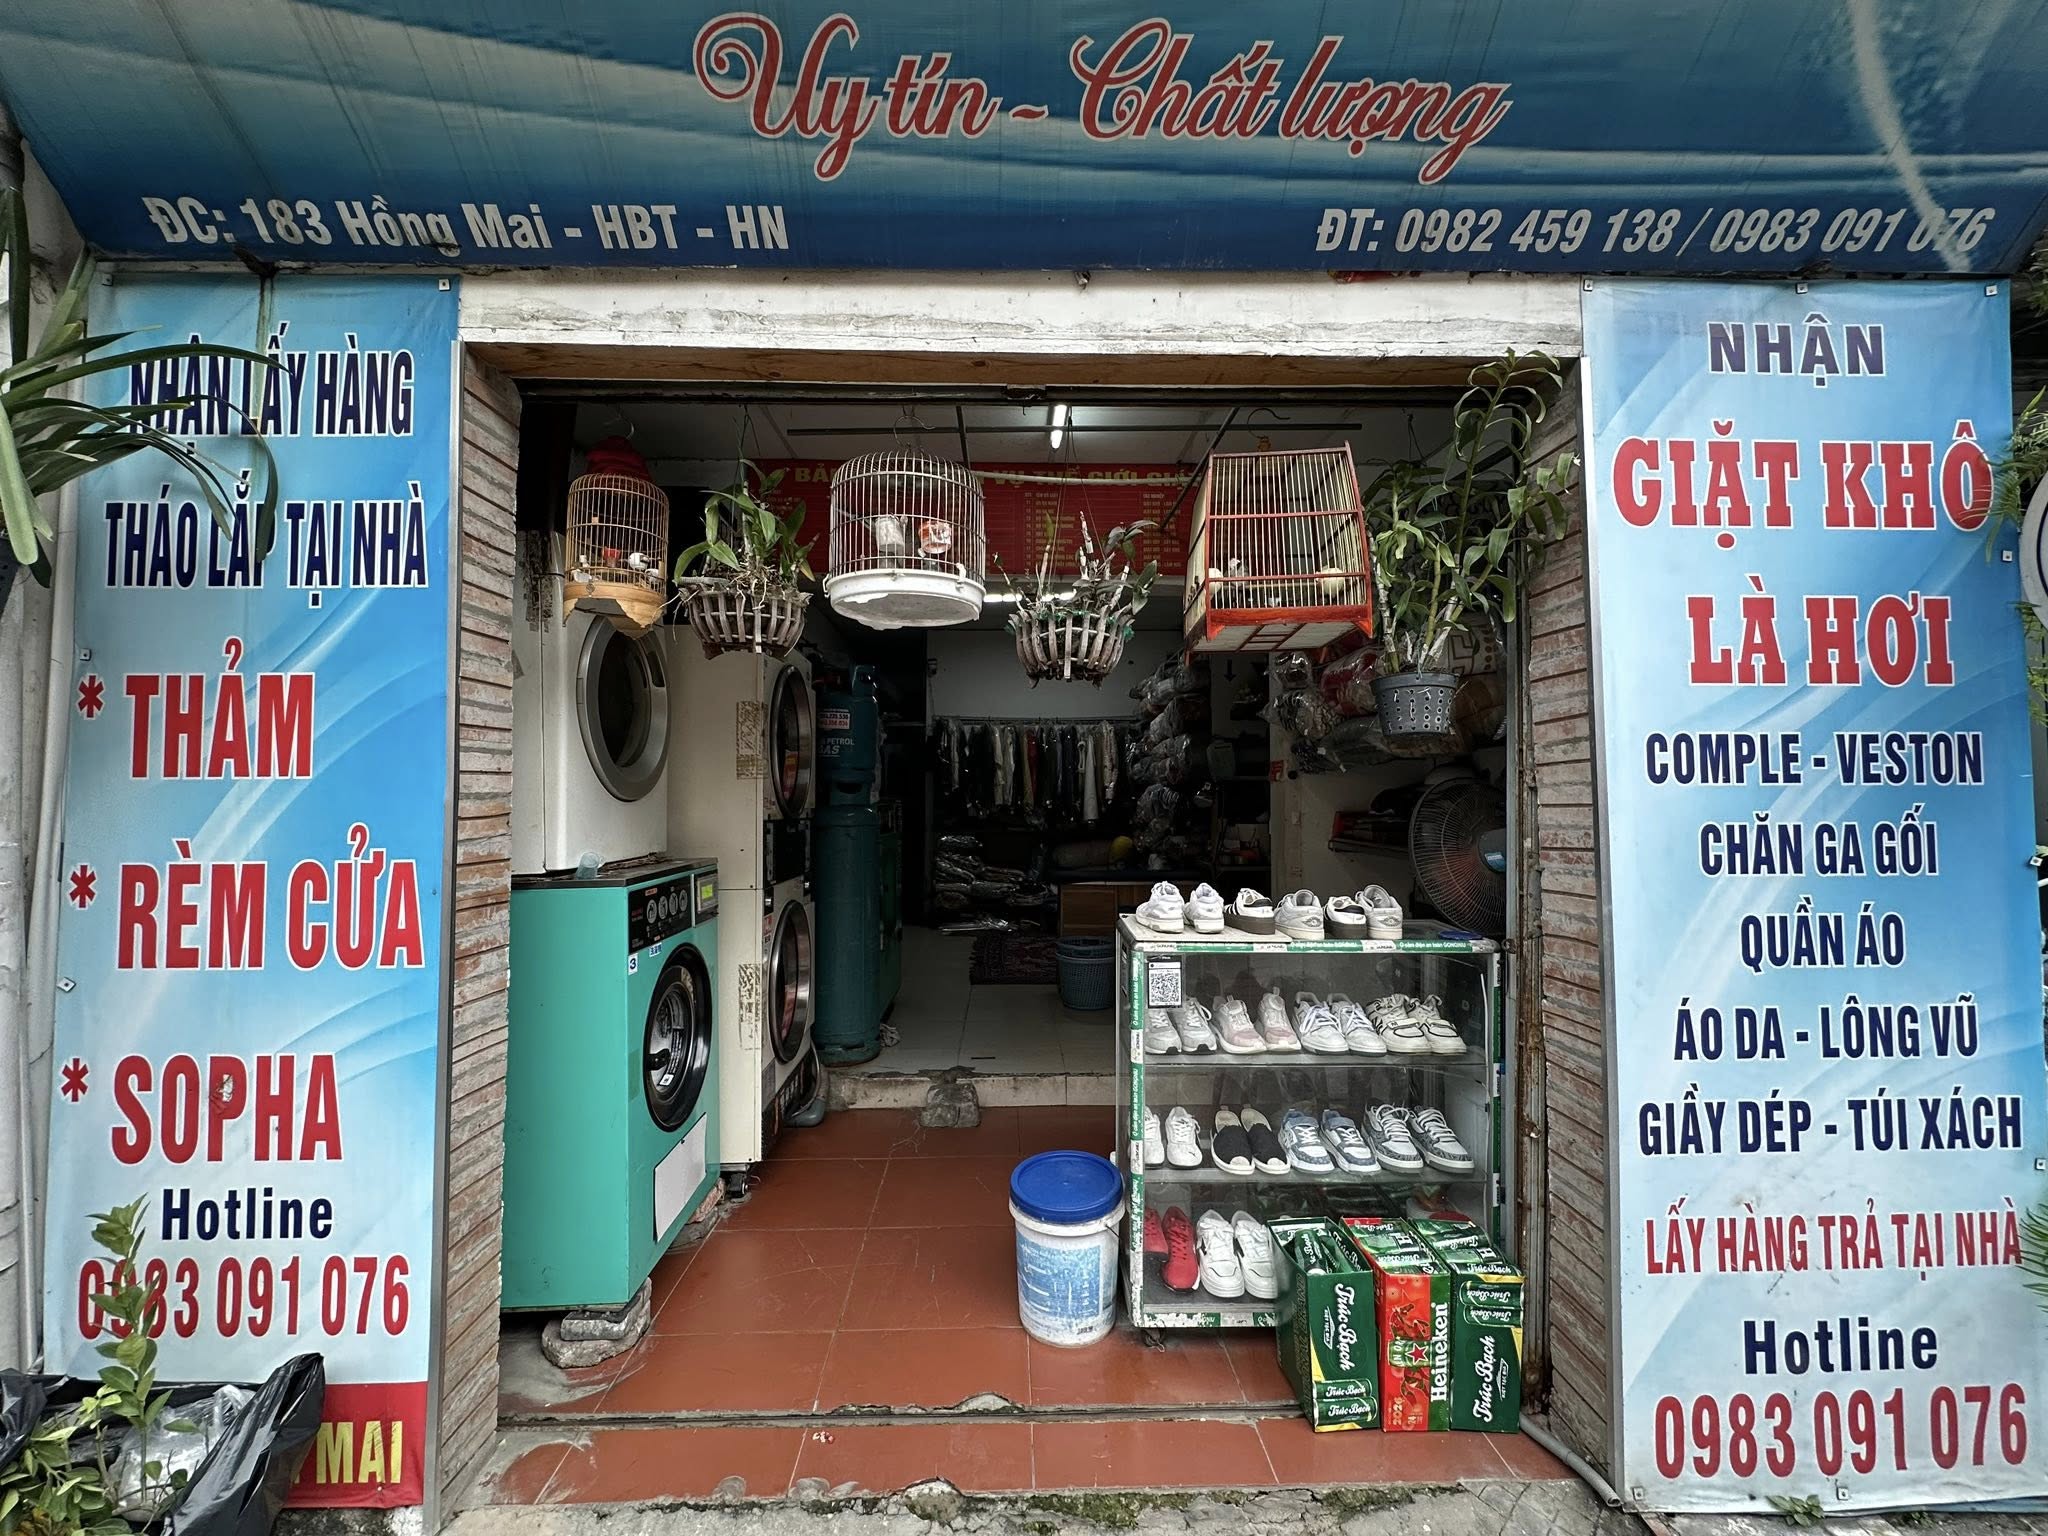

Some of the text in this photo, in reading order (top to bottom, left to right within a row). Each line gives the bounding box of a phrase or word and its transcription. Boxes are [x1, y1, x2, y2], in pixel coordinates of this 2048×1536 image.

[692, 12, 874, 182] Uy
[884, 49, 1002, 141] tín
[1069, 16, 1286, 142] Chất
[1281, 33, 1512, 186] lượng
[141, 196, 234, 246] ĐC:
[240, 197, 331, 248] 183
[336, 194, 462, 258] Hồng
[468, 201, 556, 251] Mai
[592, 203, 680, 251] HBT
[728, 204, 792, 251] HN
[1314, 209, 1384, 254] ĐT:
[1397, 209, 1496, 254] 0982
[1508, 208, 1594, 254] 459
[1602, 208, 1676, 254] 138
[1710, 208, 1816, 254] 0983
[1820, 208, 1914, 254] 091
[1914, 208, 1996, 254] 076
[128, 322, 414, 455] NHẬN LẤY HÀNG
[1707, 312, 1886, 388] NHẬN
[1611, 419, 1996, 550] GIẶT KHÔ
[104, 483, 199, 589] THÁO
[286, 500, 343, 609] TẠI
[351, 480, 429, 589] NHÀ
[1685, 574, 1955, 687] LÀ HƠI
[123, 636, 316, 780] THẢM
[1645, 732, 1803, 786] COMPLE
[1835, 732, 1985, 786] VESTON
[1698, 803, 1939, 877] CHĂN GA GỐI
[117, 822, 427, 972] RÈM CỬA
[1740, 895, 1906, 974] QUẦN ÁO
[629, 957, 637, 970] 3
[1673, 997, 1723, 1062] ÁO
[1735, 1006, 1786, 1060] DA
[1820, 995, 1922, 1059] LÔNG
[1930, 994, 1979, 1058] VŨ
[110, 1053, 343, 1165] SOPHA
[1638, 1083, 1726, 1157] GIẦY
[1738, 1088, 1813, 1154] DÉP
[1847, 1087, 1910, 1152] TÚI
[1919, 1085, 2023, 1152] XÁCH
[160, 1185, 335, 1243] Hotline
[1645, 1195, 2023, 1282] LẤY HÀNG TRẢ TẠI NHÀ
[215, 1254, 300, 1340] 091
[321, 1254, 411, 1338] 076
[1334, 1283, 1358, 1371] Trúc Bạch
[1430, 1302, 1449, 1402] Heineken
[1472, 1335, 1496, 1423] Trúc Bạch
[1743, 1319, 1939, 1375] Hotline
[316, 1420, 402, 1484] MAI
[1392, 1396, 1405, 1426] 2026
[1654, 1382, 2028, 1480] 0983 091 076
